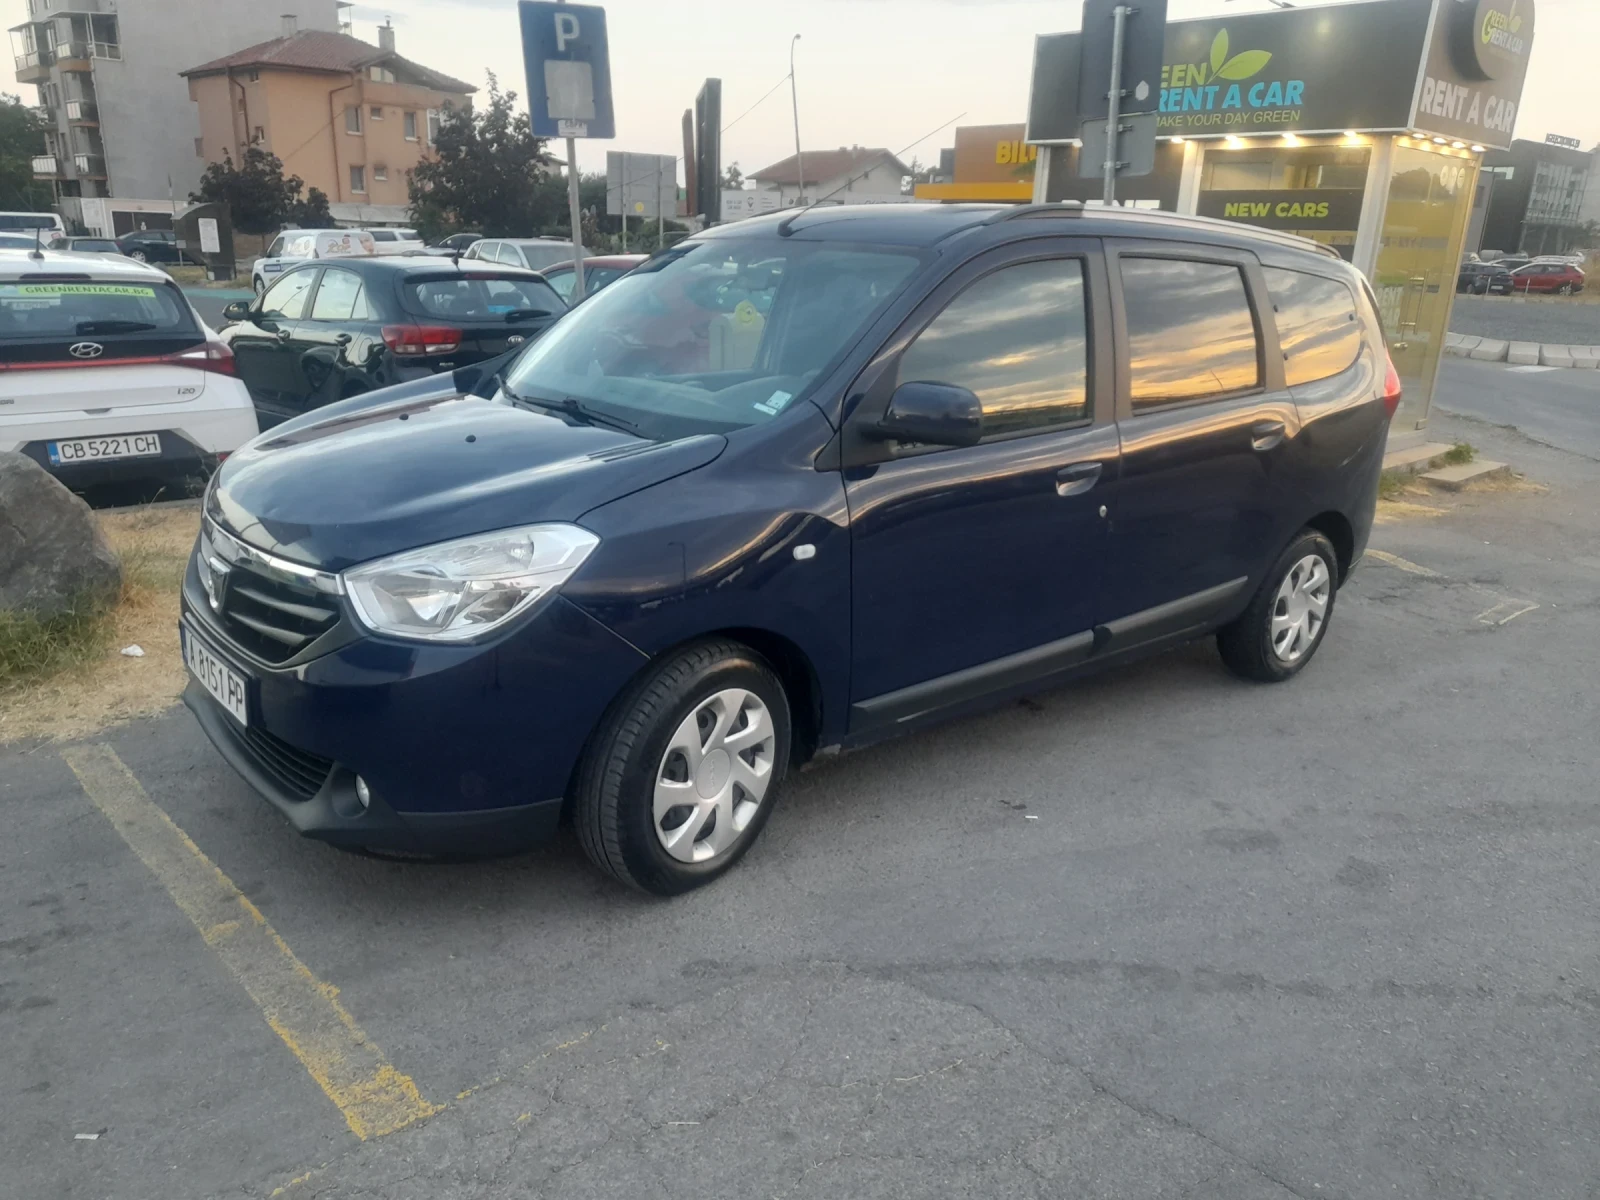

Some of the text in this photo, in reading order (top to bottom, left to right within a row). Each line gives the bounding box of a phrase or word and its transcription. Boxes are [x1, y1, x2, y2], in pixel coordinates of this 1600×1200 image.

[554, 12, 580, 52] P
[1160, 62, 1208, 88] EEN
[1159, 80, 1305, 112] RENT A CAR
[1420, 77, 1517, 133] RENT A CAR
[1186, 114, 1222, 126] YOUR
[1224, 112, 1251, 125] DAY
[1253, 110, 1301, 123] GREEN
[1224, 202, 1330, 218] NEW CARS
[24, 285, 150, 296] GREENRENTACAR.BG
[61, 436, 158, 459] CB 5221 CH
[189, 635, 243, 712] A 8151 PP
